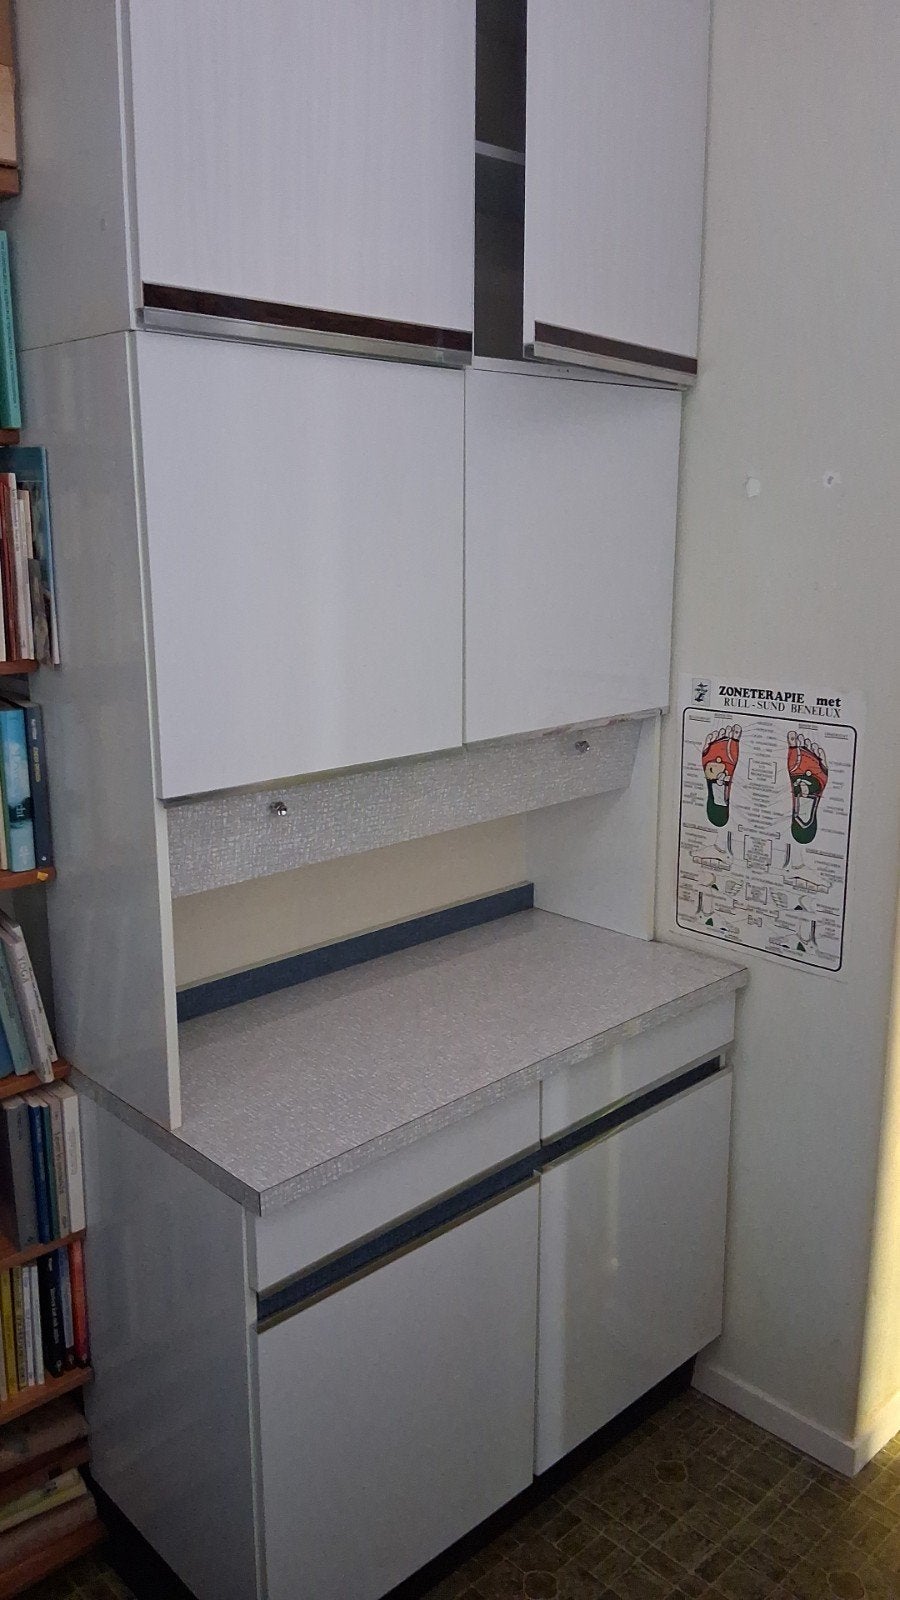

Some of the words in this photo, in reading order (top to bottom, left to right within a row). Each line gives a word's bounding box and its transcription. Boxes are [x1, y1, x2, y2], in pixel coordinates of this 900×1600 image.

[719, 686, 805, 703] ZONETERAPIE
[816, 697, 841, 707] met
[791, 704, 841, 719] BENELUX
